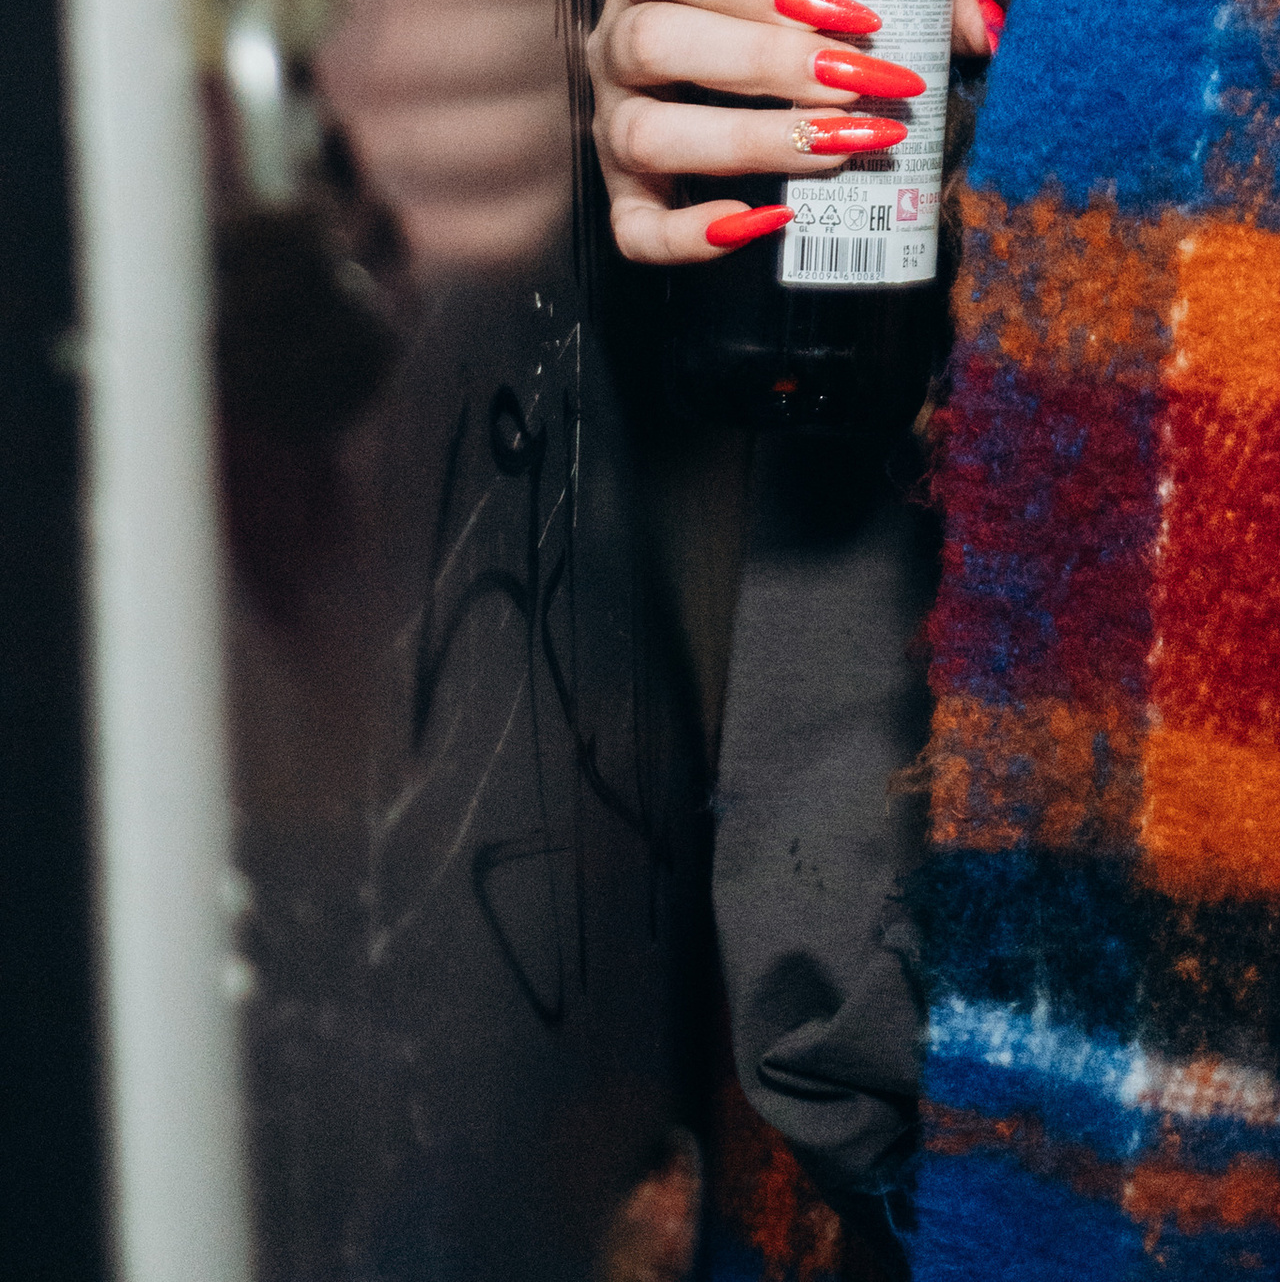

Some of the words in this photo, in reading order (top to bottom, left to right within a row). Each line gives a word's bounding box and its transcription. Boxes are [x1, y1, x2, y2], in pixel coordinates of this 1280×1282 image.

[849, 158, 903, 173] ВАШЕМУ
[791, 186, 836, 202] ОБЪЁМ
[837, 186, 860, 204] 0,45
[825, 226, 835, 234] FE
